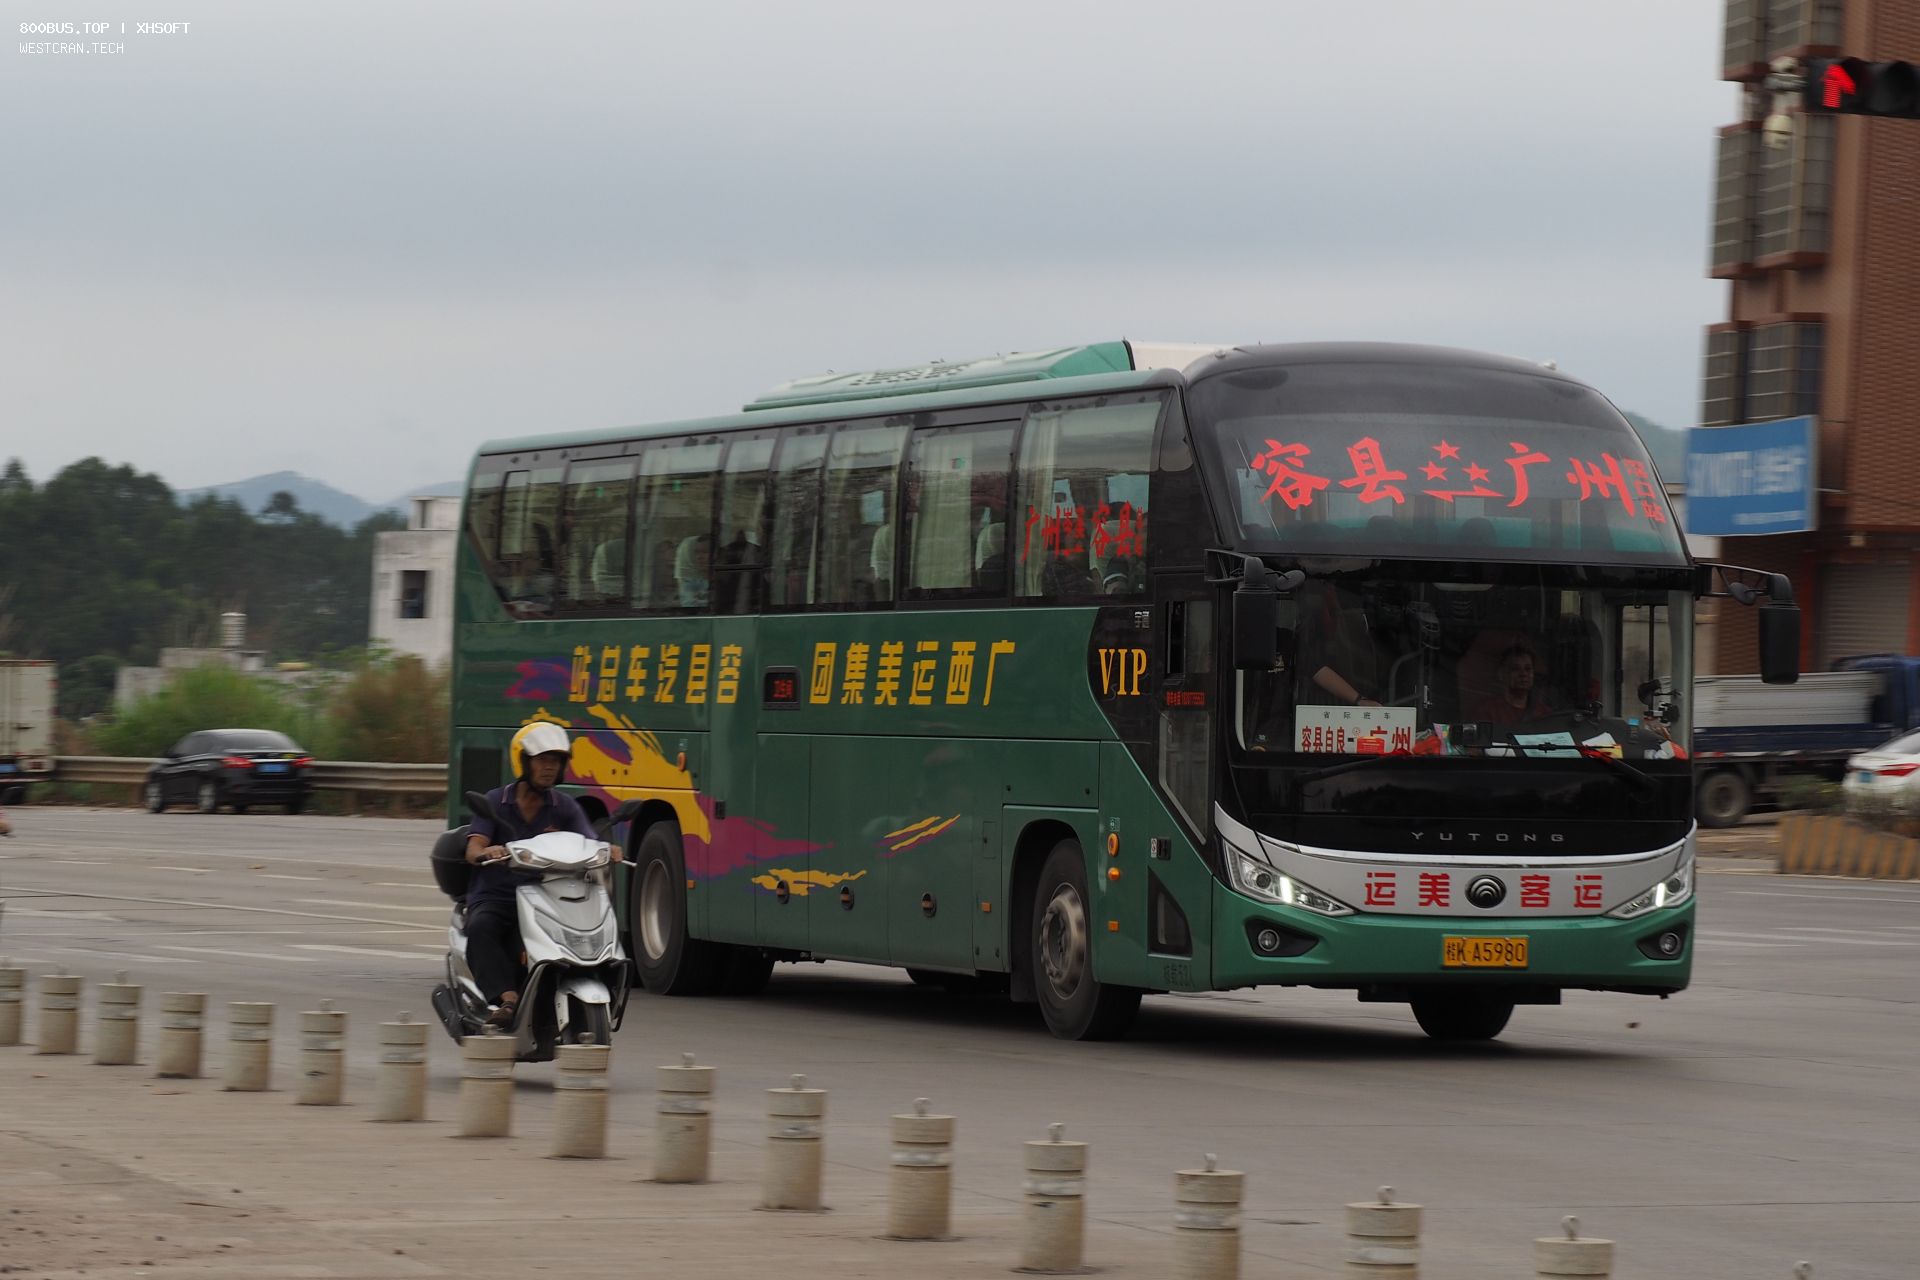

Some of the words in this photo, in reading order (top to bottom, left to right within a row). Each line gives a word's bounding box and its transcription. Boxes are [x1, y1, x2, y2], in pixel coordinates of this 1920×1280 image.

[1251, 437, 1408, 511] 容县
[1504, 442, 1635, 518] 广州
[1098, 648, 1147, 696] VIP
[1411, 832, 1564, 842] YUTONG
[1364, 872, 1450, 907] 运美
[1520, 874, 1602, 908] 客运
